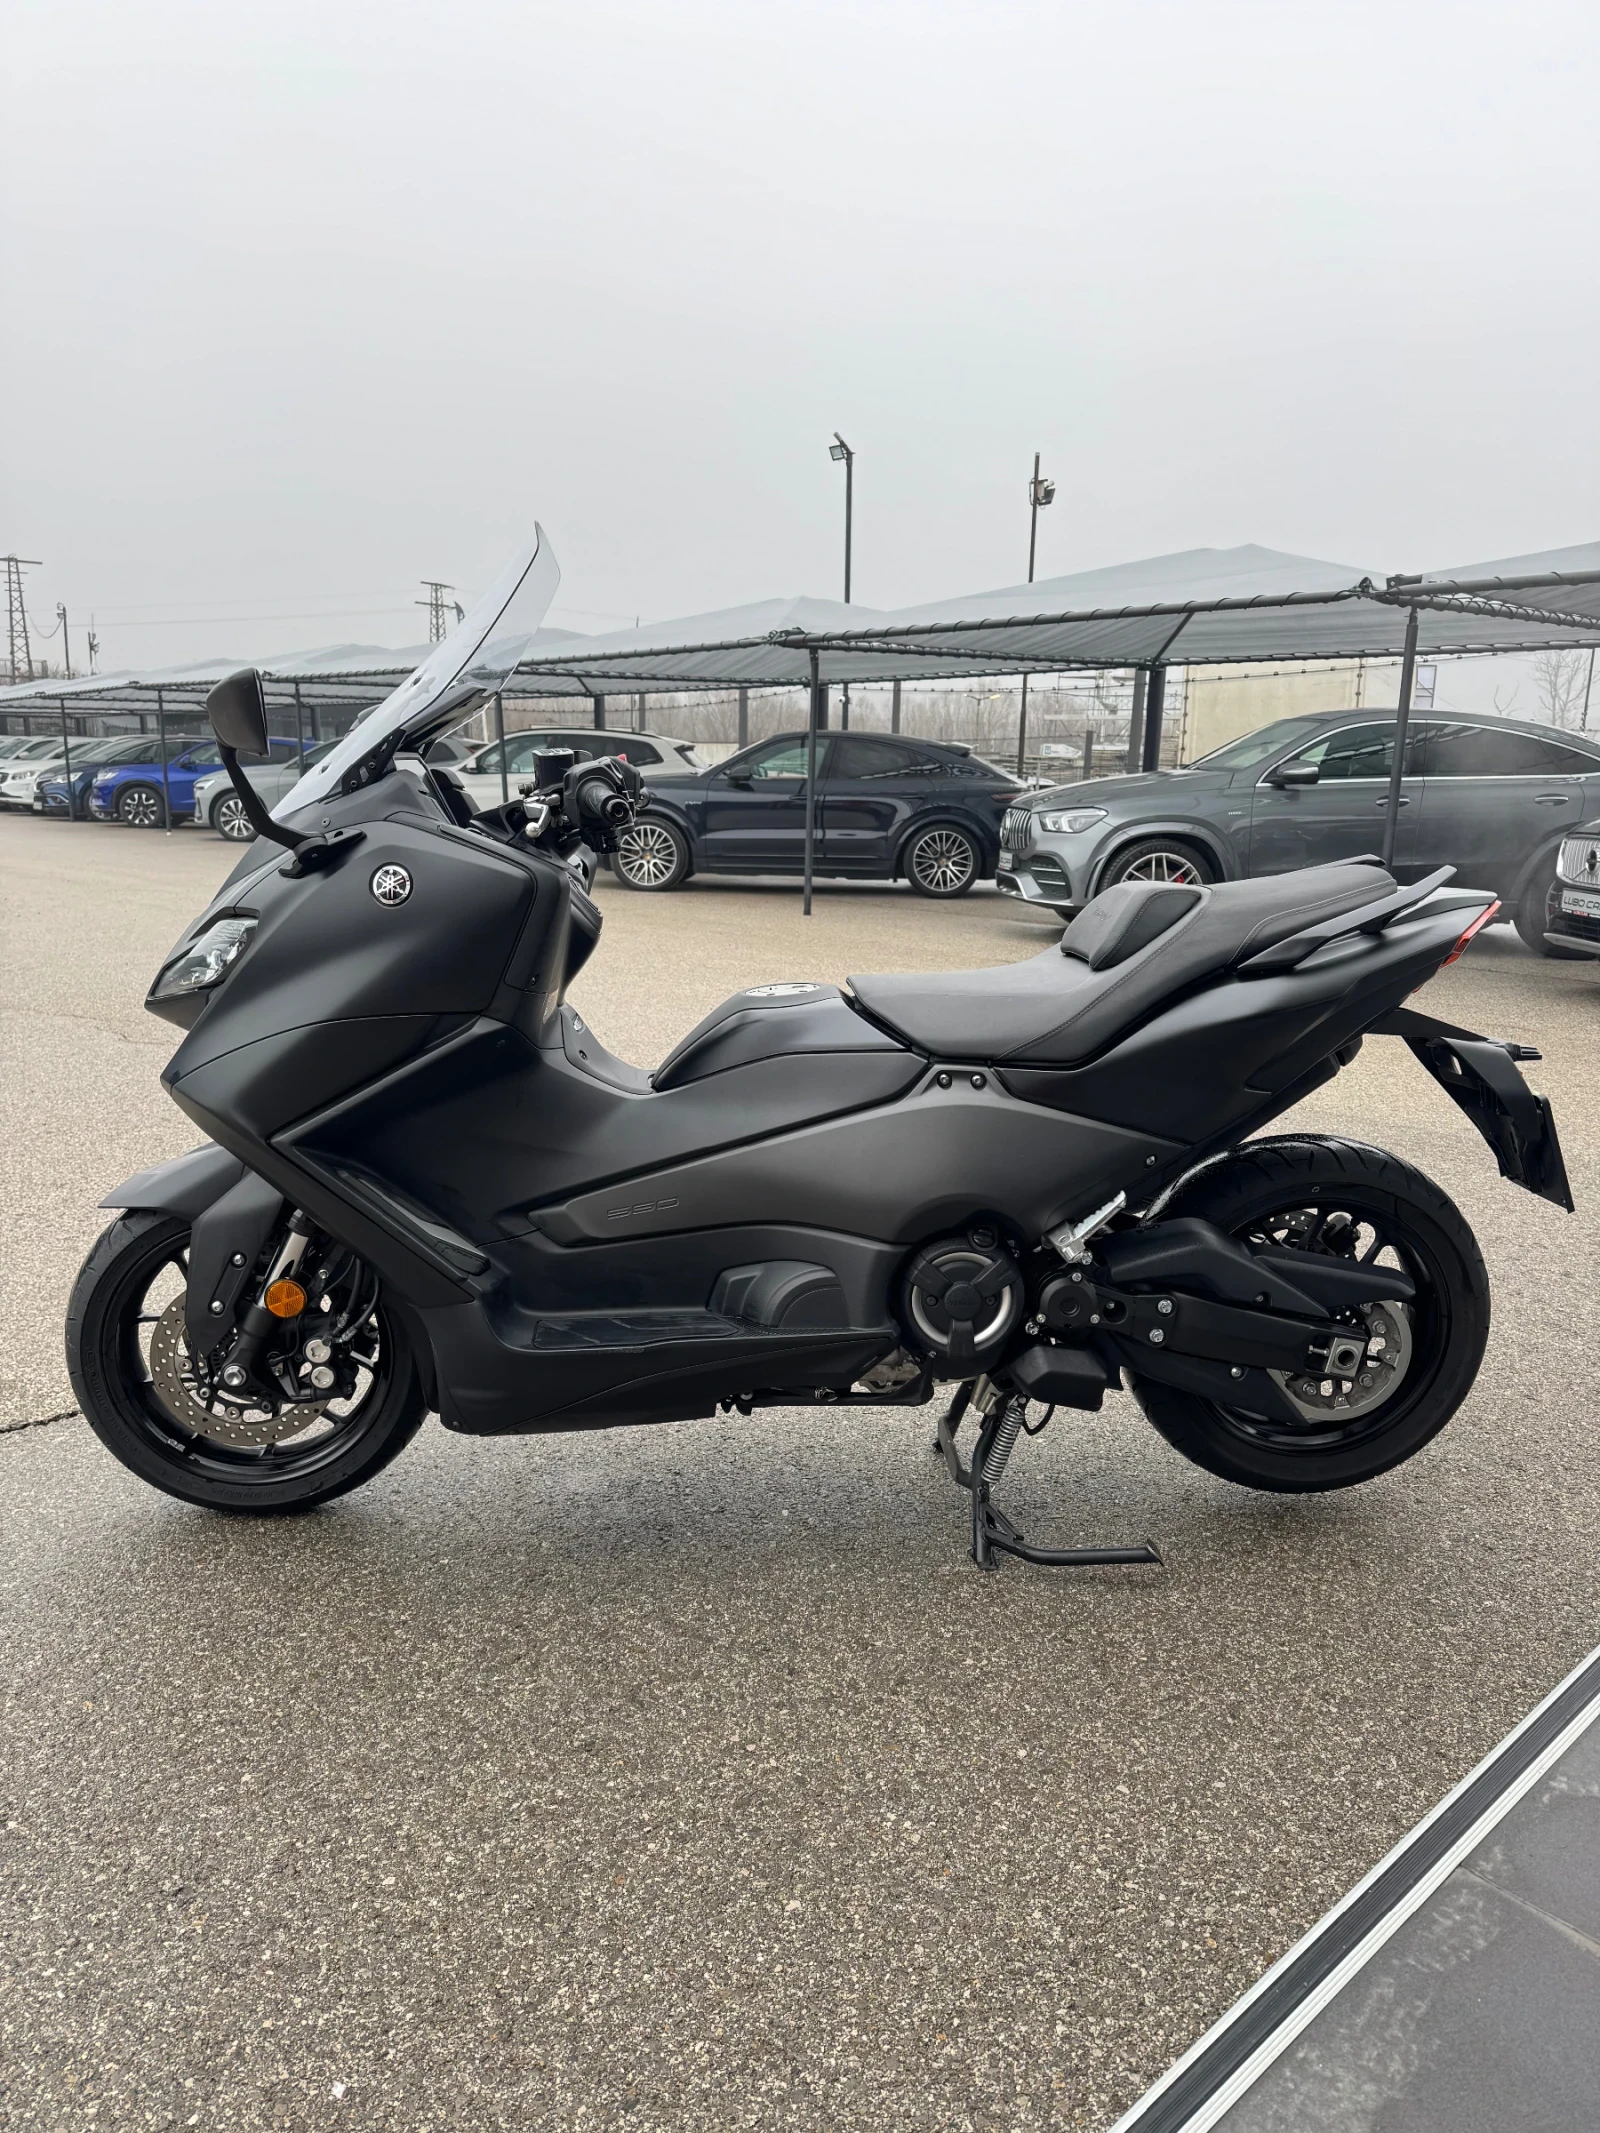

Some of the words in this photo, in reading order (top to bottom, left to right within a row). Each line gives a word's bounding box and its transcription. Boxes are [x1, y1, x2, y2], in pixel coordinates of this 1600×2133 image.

[1563, 896, 1586, 908] LUBO
[1586, 900, 1600, 911] CA
[607, 1196, 679, 1220] 560
